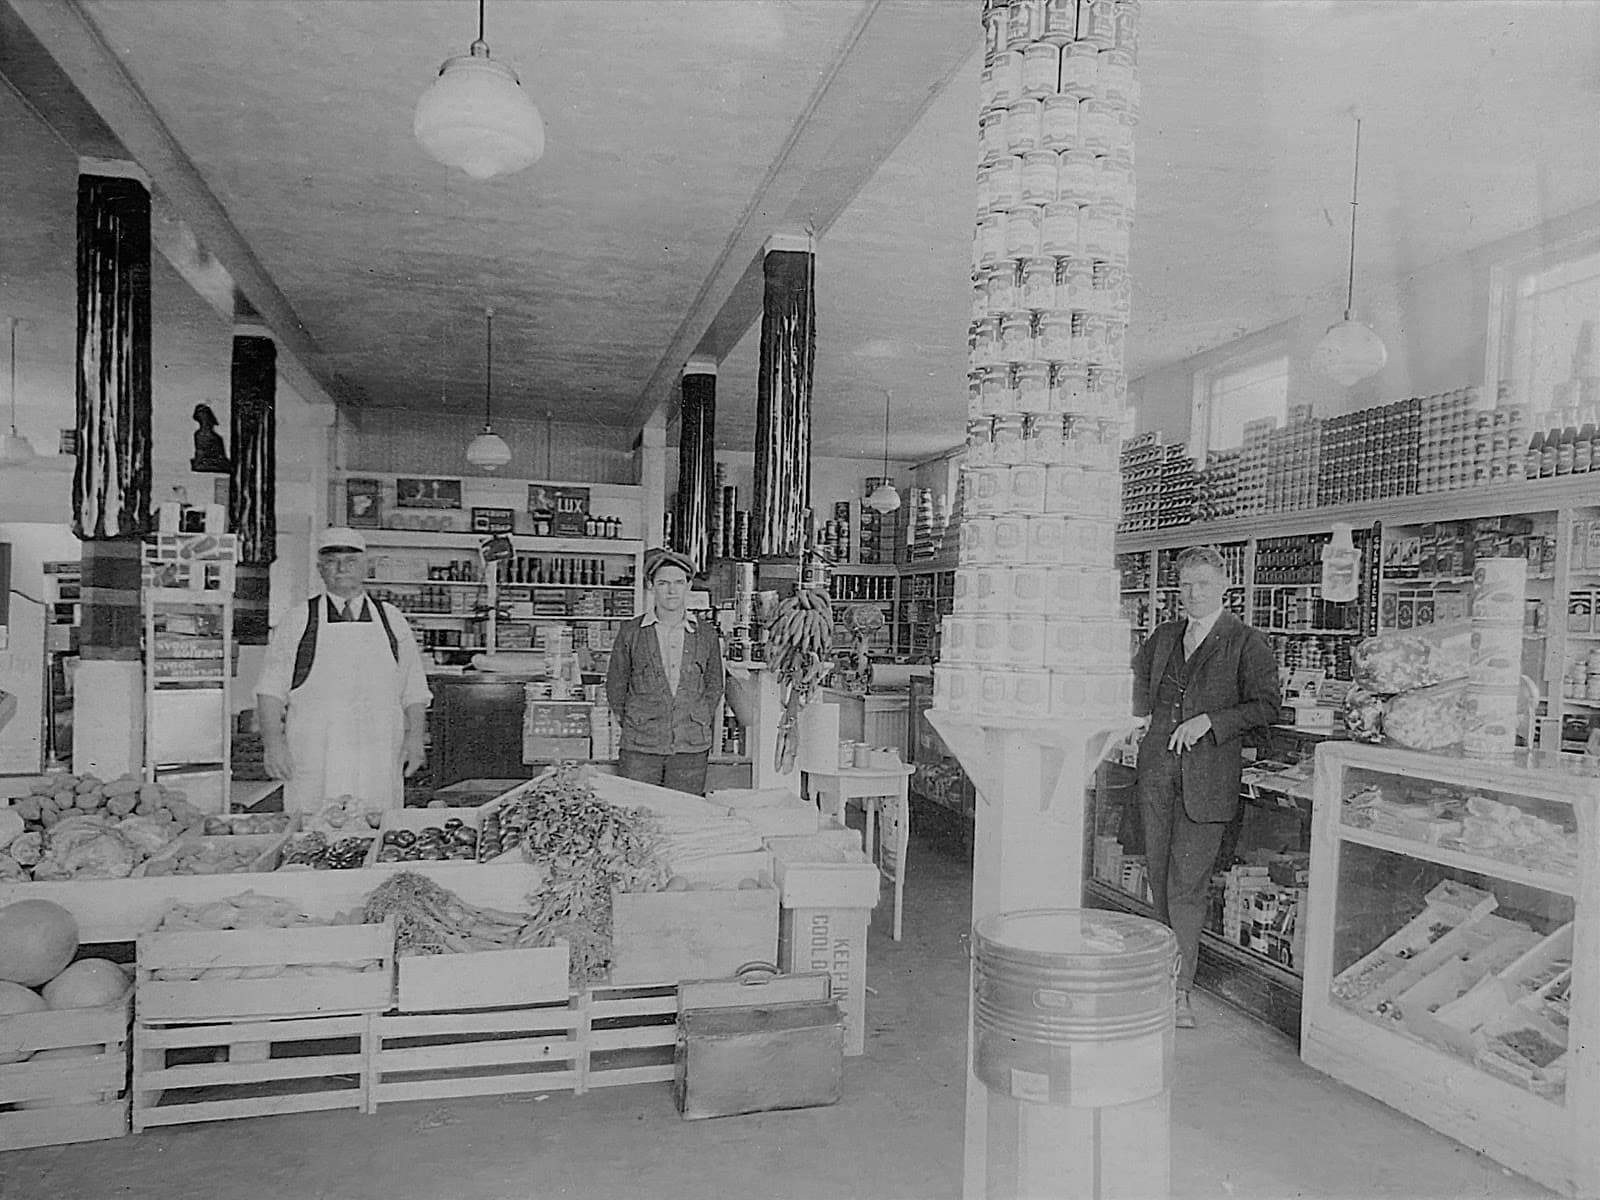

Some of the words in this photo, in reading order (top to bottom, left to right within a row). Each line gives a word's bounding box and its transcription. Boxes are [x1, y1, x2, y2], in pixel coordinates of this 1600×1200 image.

[558, 498, 583, 513] LUX
[811, 915, 829, 957] COOL
[833, 938, 849, 981] KEEP
[833, 986, 849, 1002] IN
